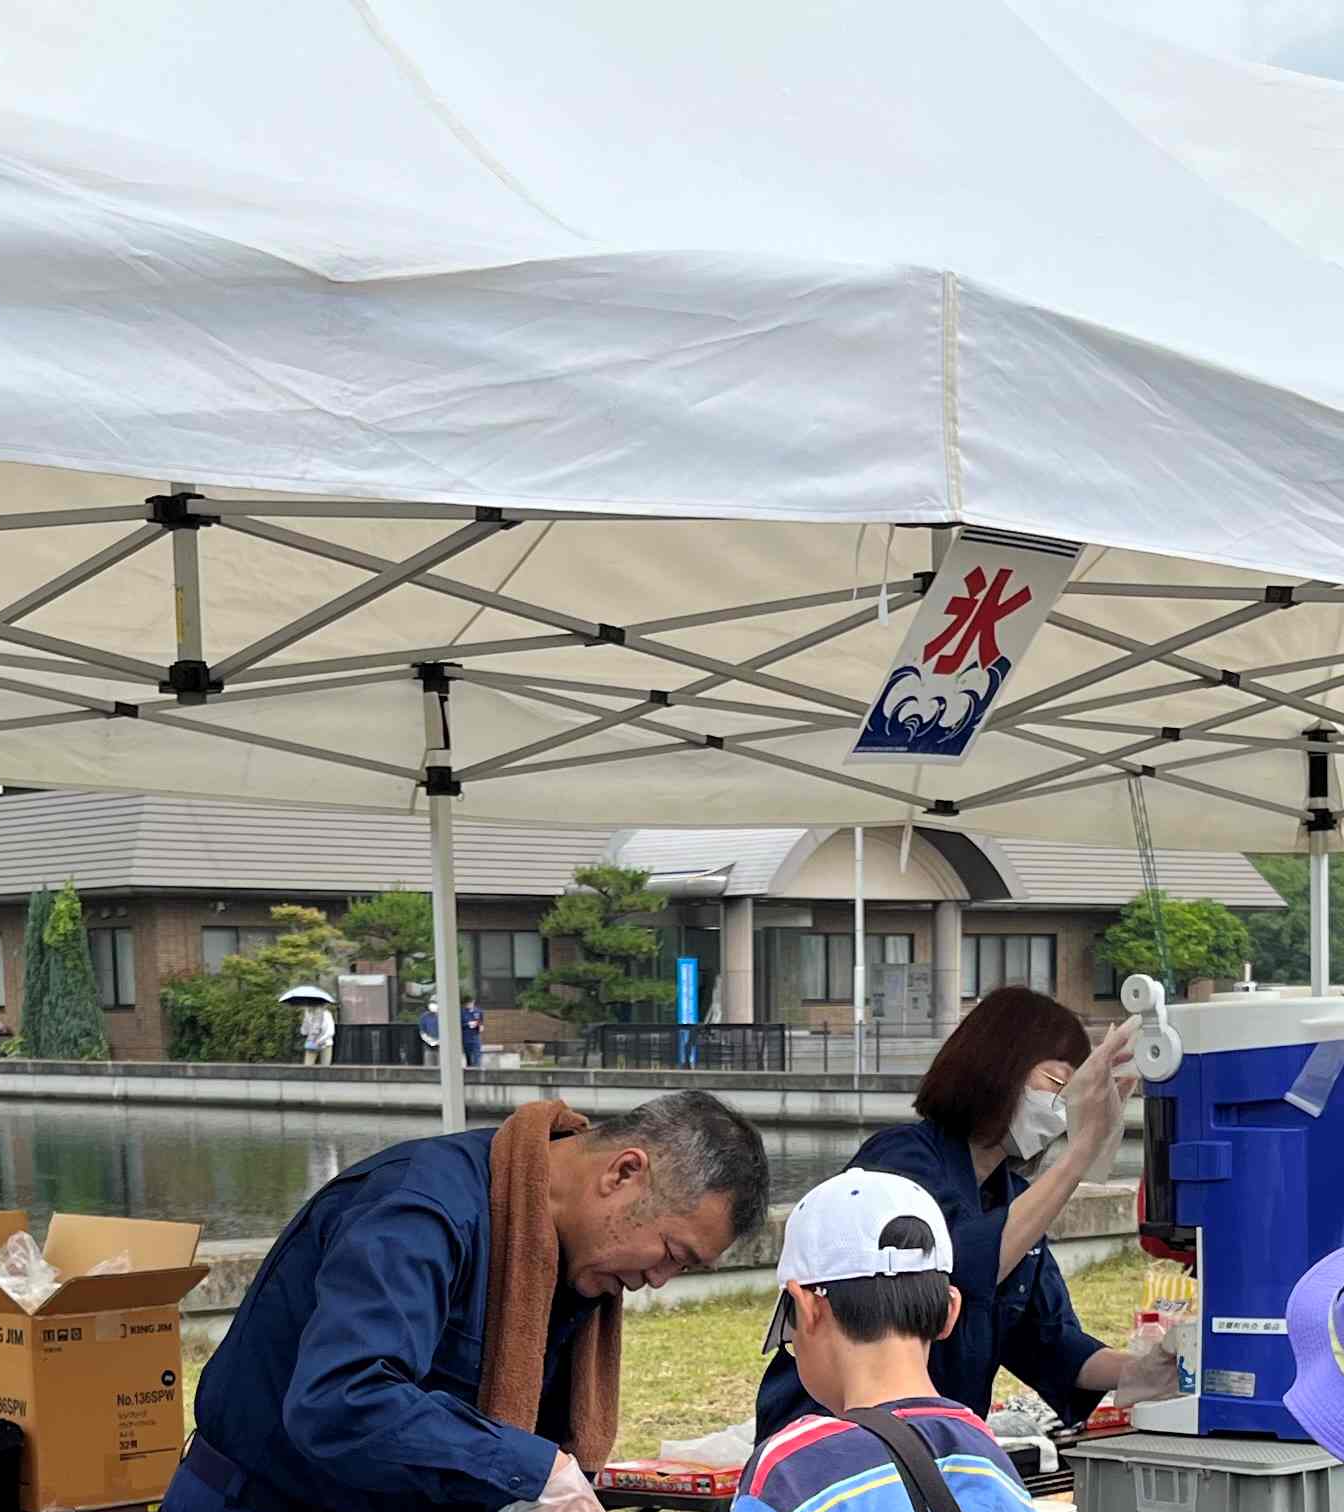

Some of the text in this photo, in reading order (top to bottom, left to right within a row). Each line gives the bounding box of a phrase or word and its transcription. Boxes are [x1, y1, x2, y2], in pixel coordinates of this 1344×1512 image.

[921, 565, 1032, 675] 氷
[6, 1328, 25, 1346] JIM
[129, 1323, 173, 1335] KING JIM
